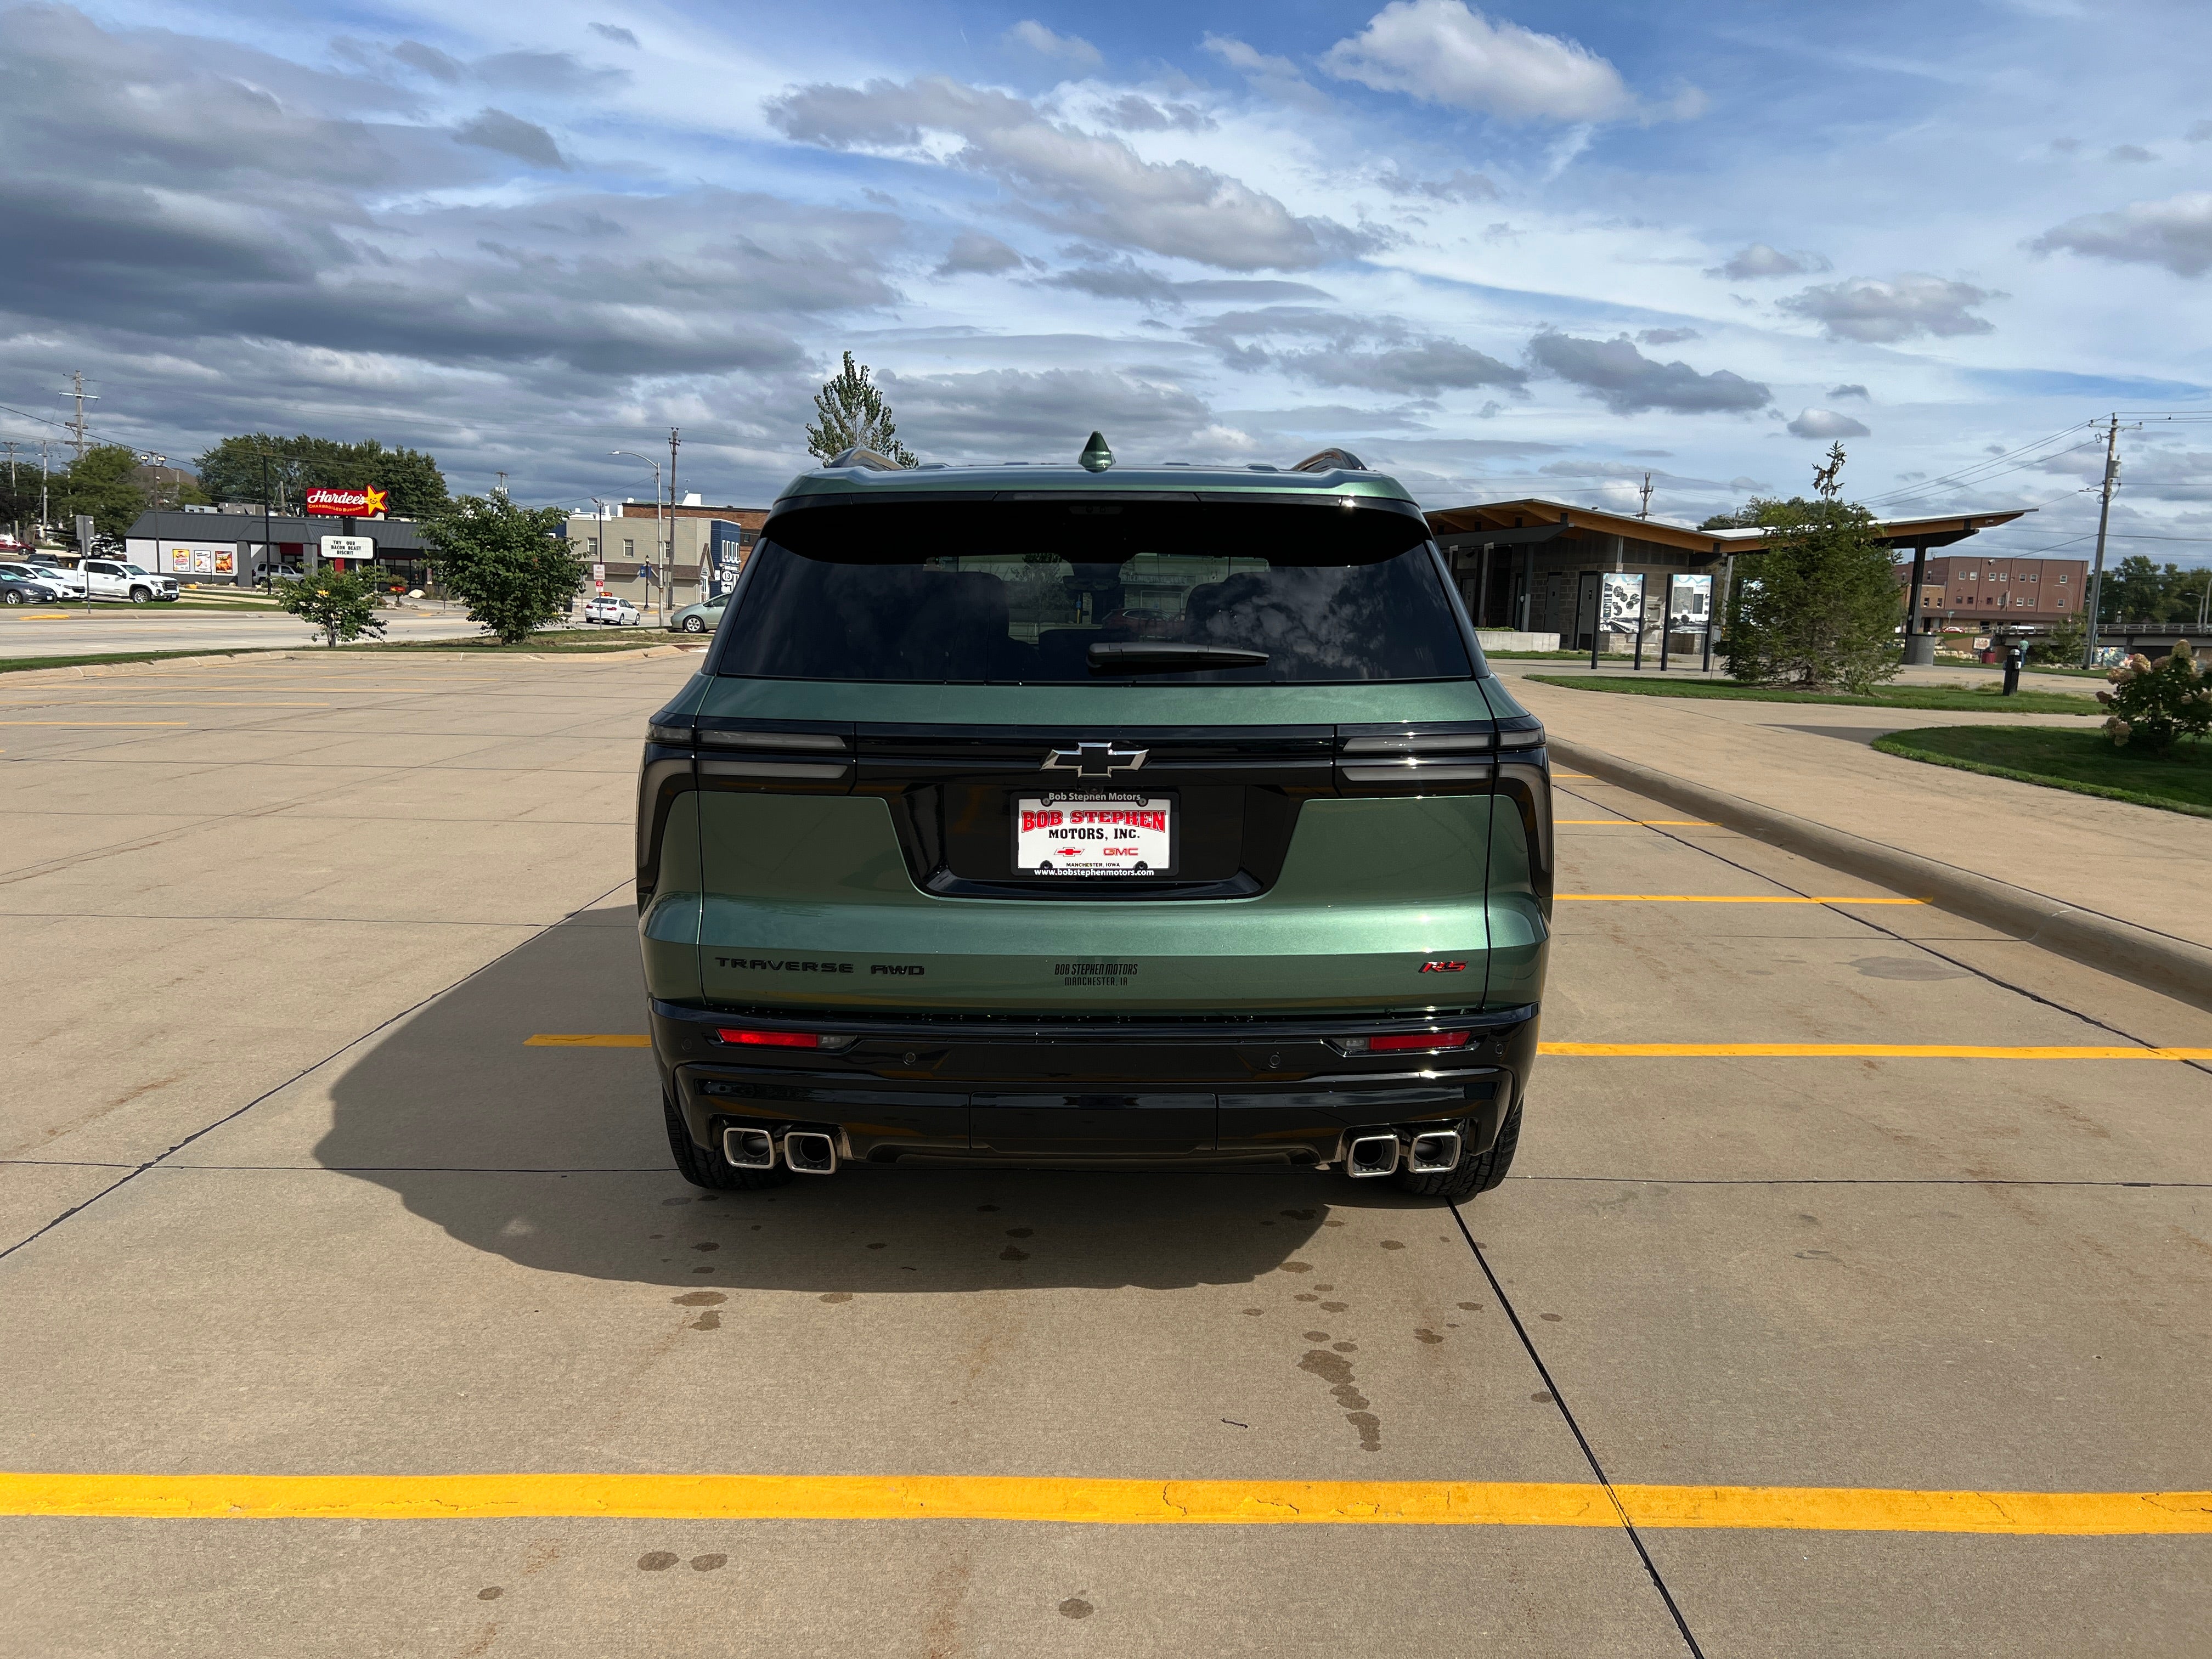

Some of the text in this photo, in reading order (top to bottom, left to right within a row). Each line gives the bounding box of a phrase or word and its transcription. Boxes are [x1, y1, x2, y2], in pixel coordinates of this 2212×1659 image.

[308, 490, 365, 505] Hardee's
[1070, 793, 1106, 802] Stephen
[1022, 810, 1166, 833] BOB STEPHEN
[1048, 828, 1141, 841] MOTORS, INC.
[1103, 847, 1139, 856] GMC
[1034, 868, 1155, 877] www.bobstephenmotors.com
[715, 957, 925, 975] TRAVERSE AWD
[1054, 963, 1138, 975] BOB STEPHEN MOTORS
[1418, 961, 1469, 973] RS
[1120, 977, 1128, 986] IA
